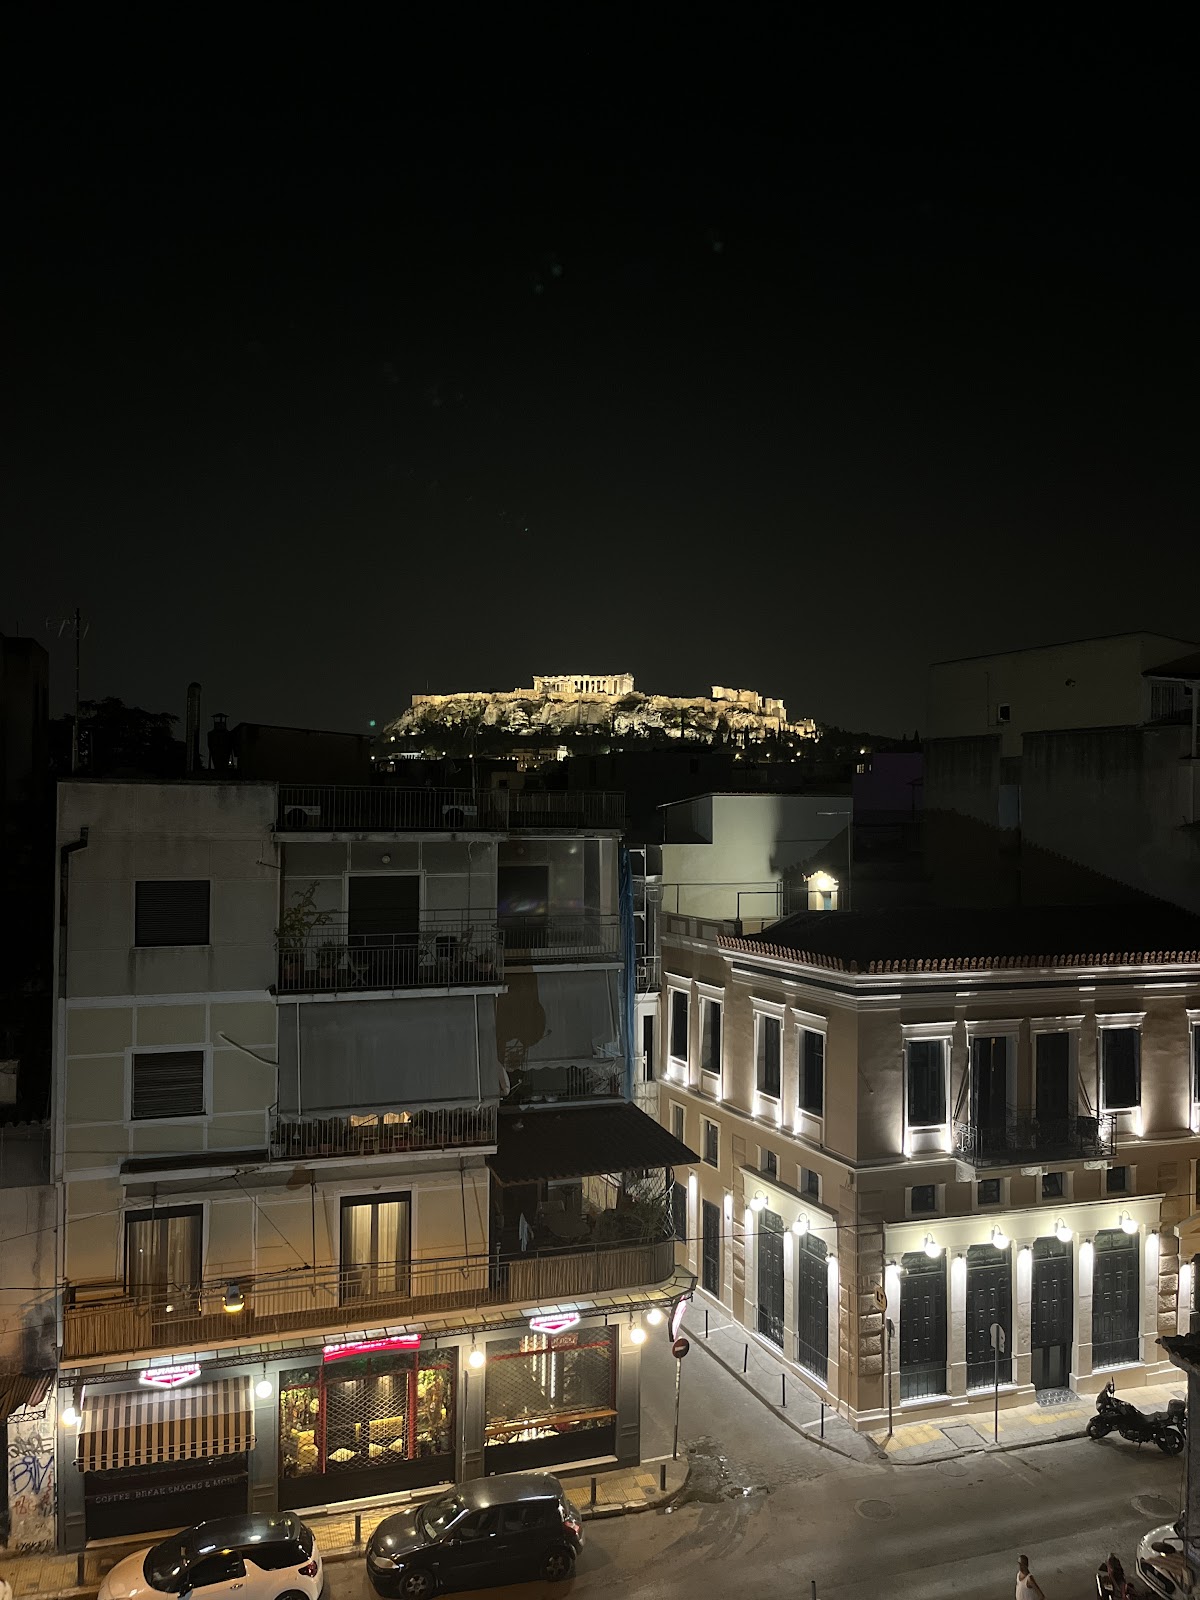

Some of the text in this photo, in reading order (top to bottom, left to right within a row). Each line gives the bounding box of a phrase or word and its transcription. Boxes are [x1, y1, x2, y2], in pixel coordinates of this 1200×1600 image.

[95, 1477, 238, 1504] COFFEE BREAK SNACKS & MORE
